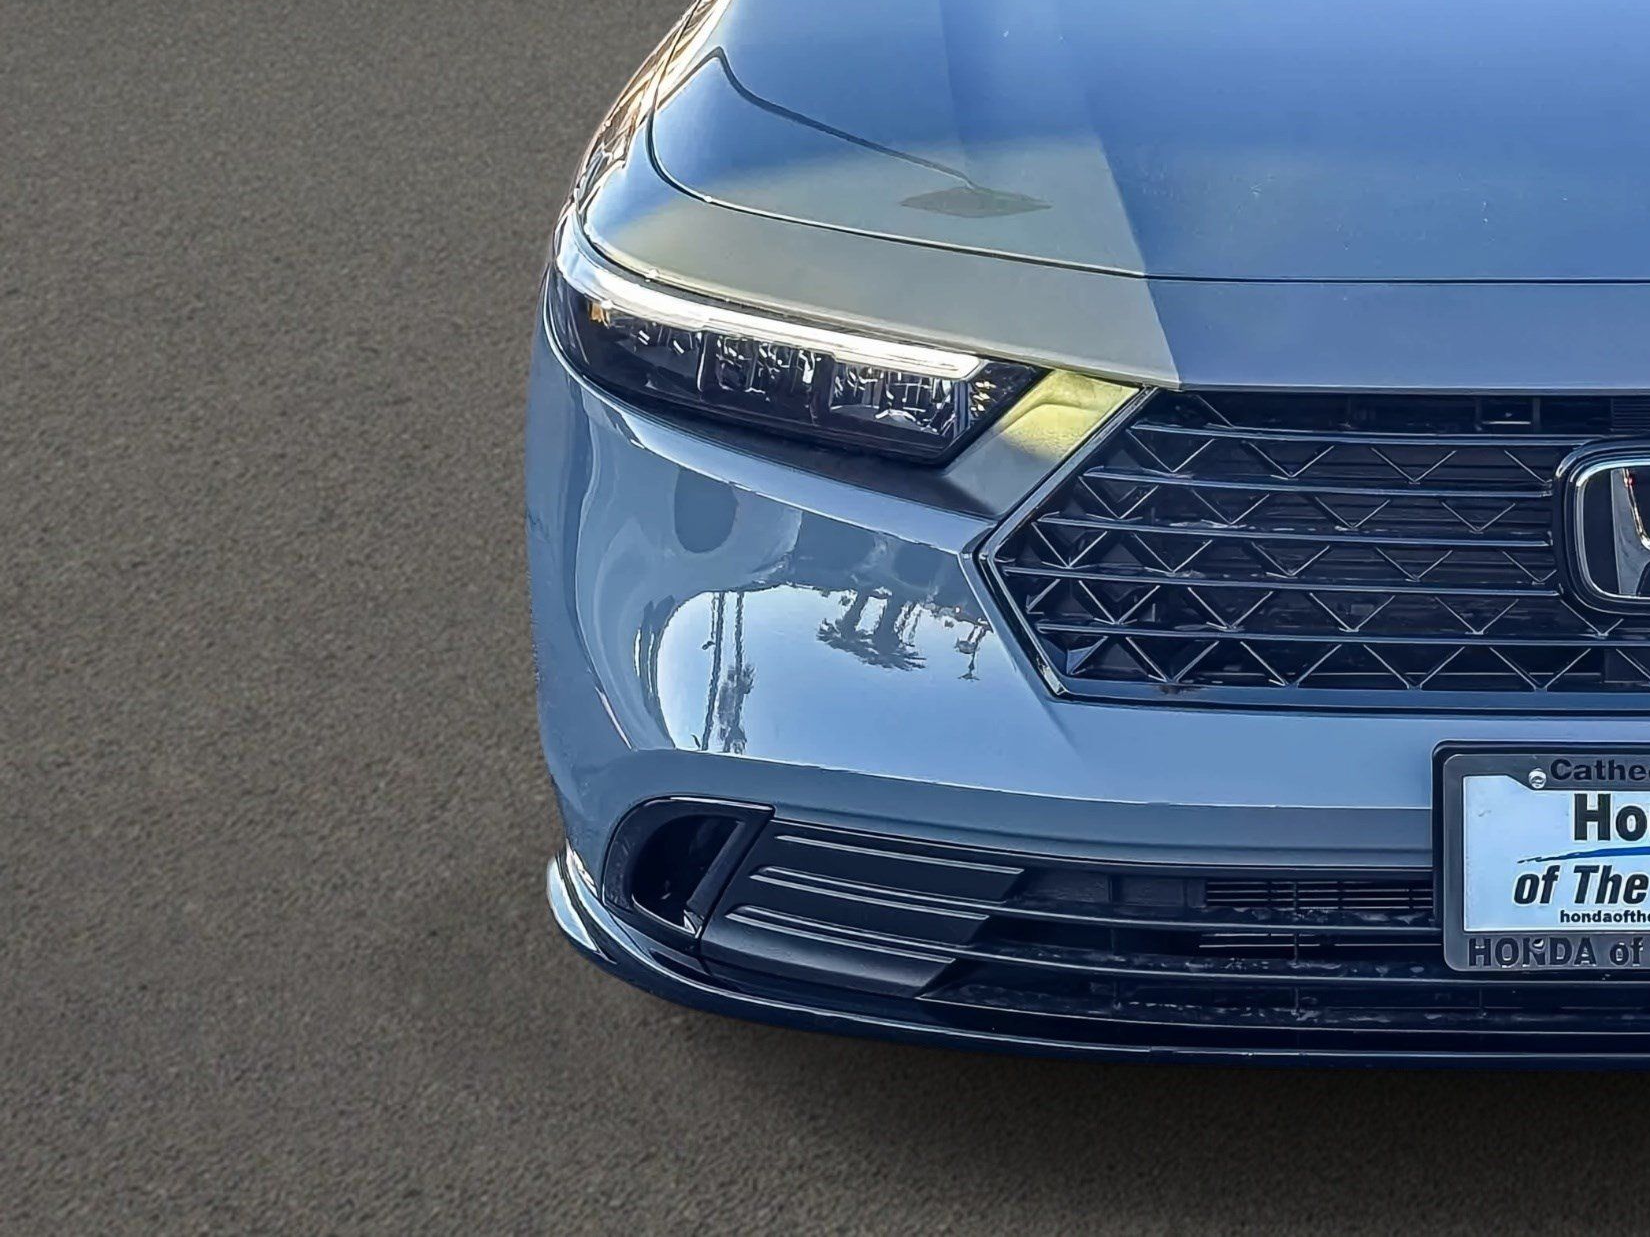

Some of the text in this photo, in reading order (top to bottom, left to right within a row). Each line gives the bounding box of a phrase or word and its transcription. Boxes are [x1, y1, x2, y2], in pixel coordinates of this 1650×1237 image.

[1513, 866, 1559, 905] of
[1573, 865, 1649, 905] The
[1467, 936, 1598, 968] HONDA
[1609, 936, 1644, 968] of
